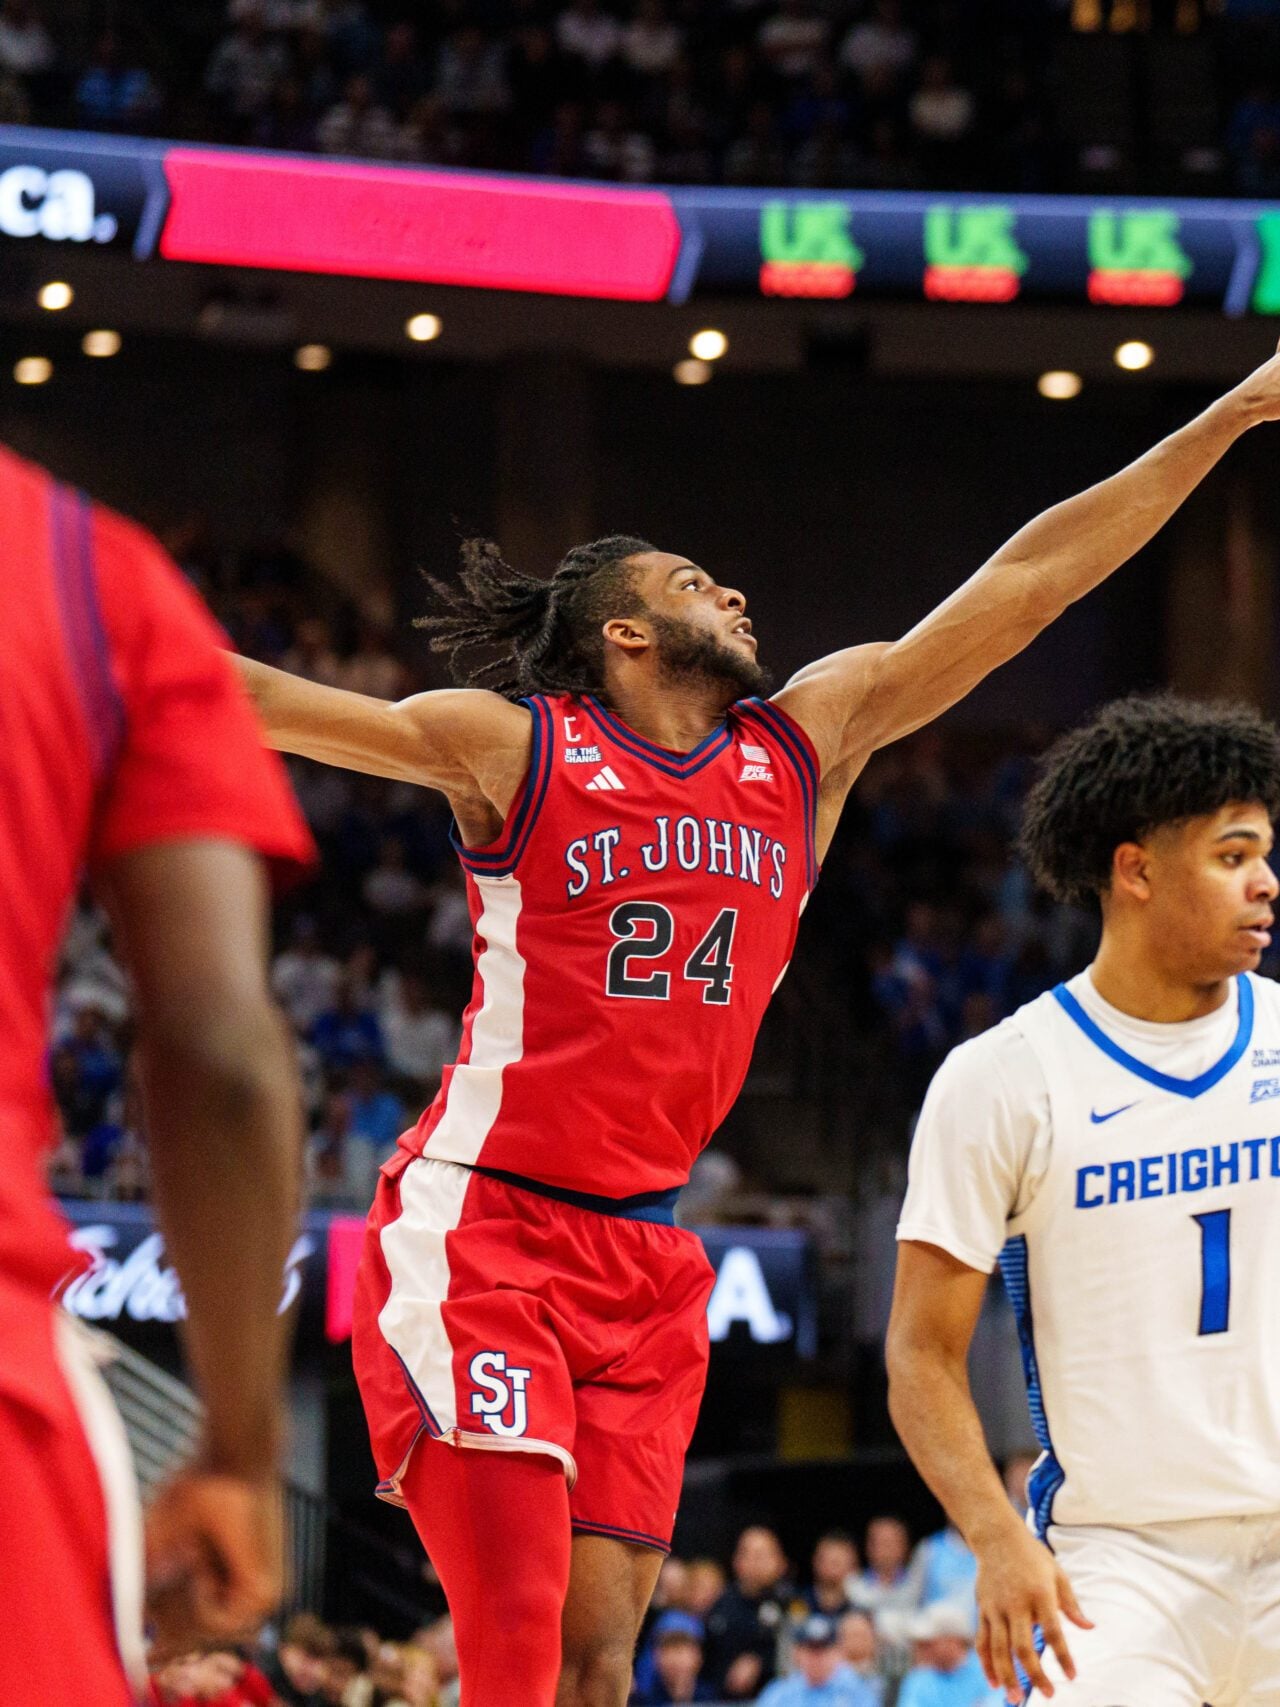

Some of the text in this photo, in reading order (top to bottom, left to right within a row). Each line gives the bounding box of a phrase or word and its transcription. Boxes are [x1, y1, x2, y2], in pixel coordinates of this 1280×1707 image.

[564, 753, 602, 763] CHANGE
[565, 745, 599, 756] BE THE
[564, 815, 787, 902] ST. JOHN'S
[605, 900, 738, 1006] 24
[1188, 1206, 1232, 1337] 1
